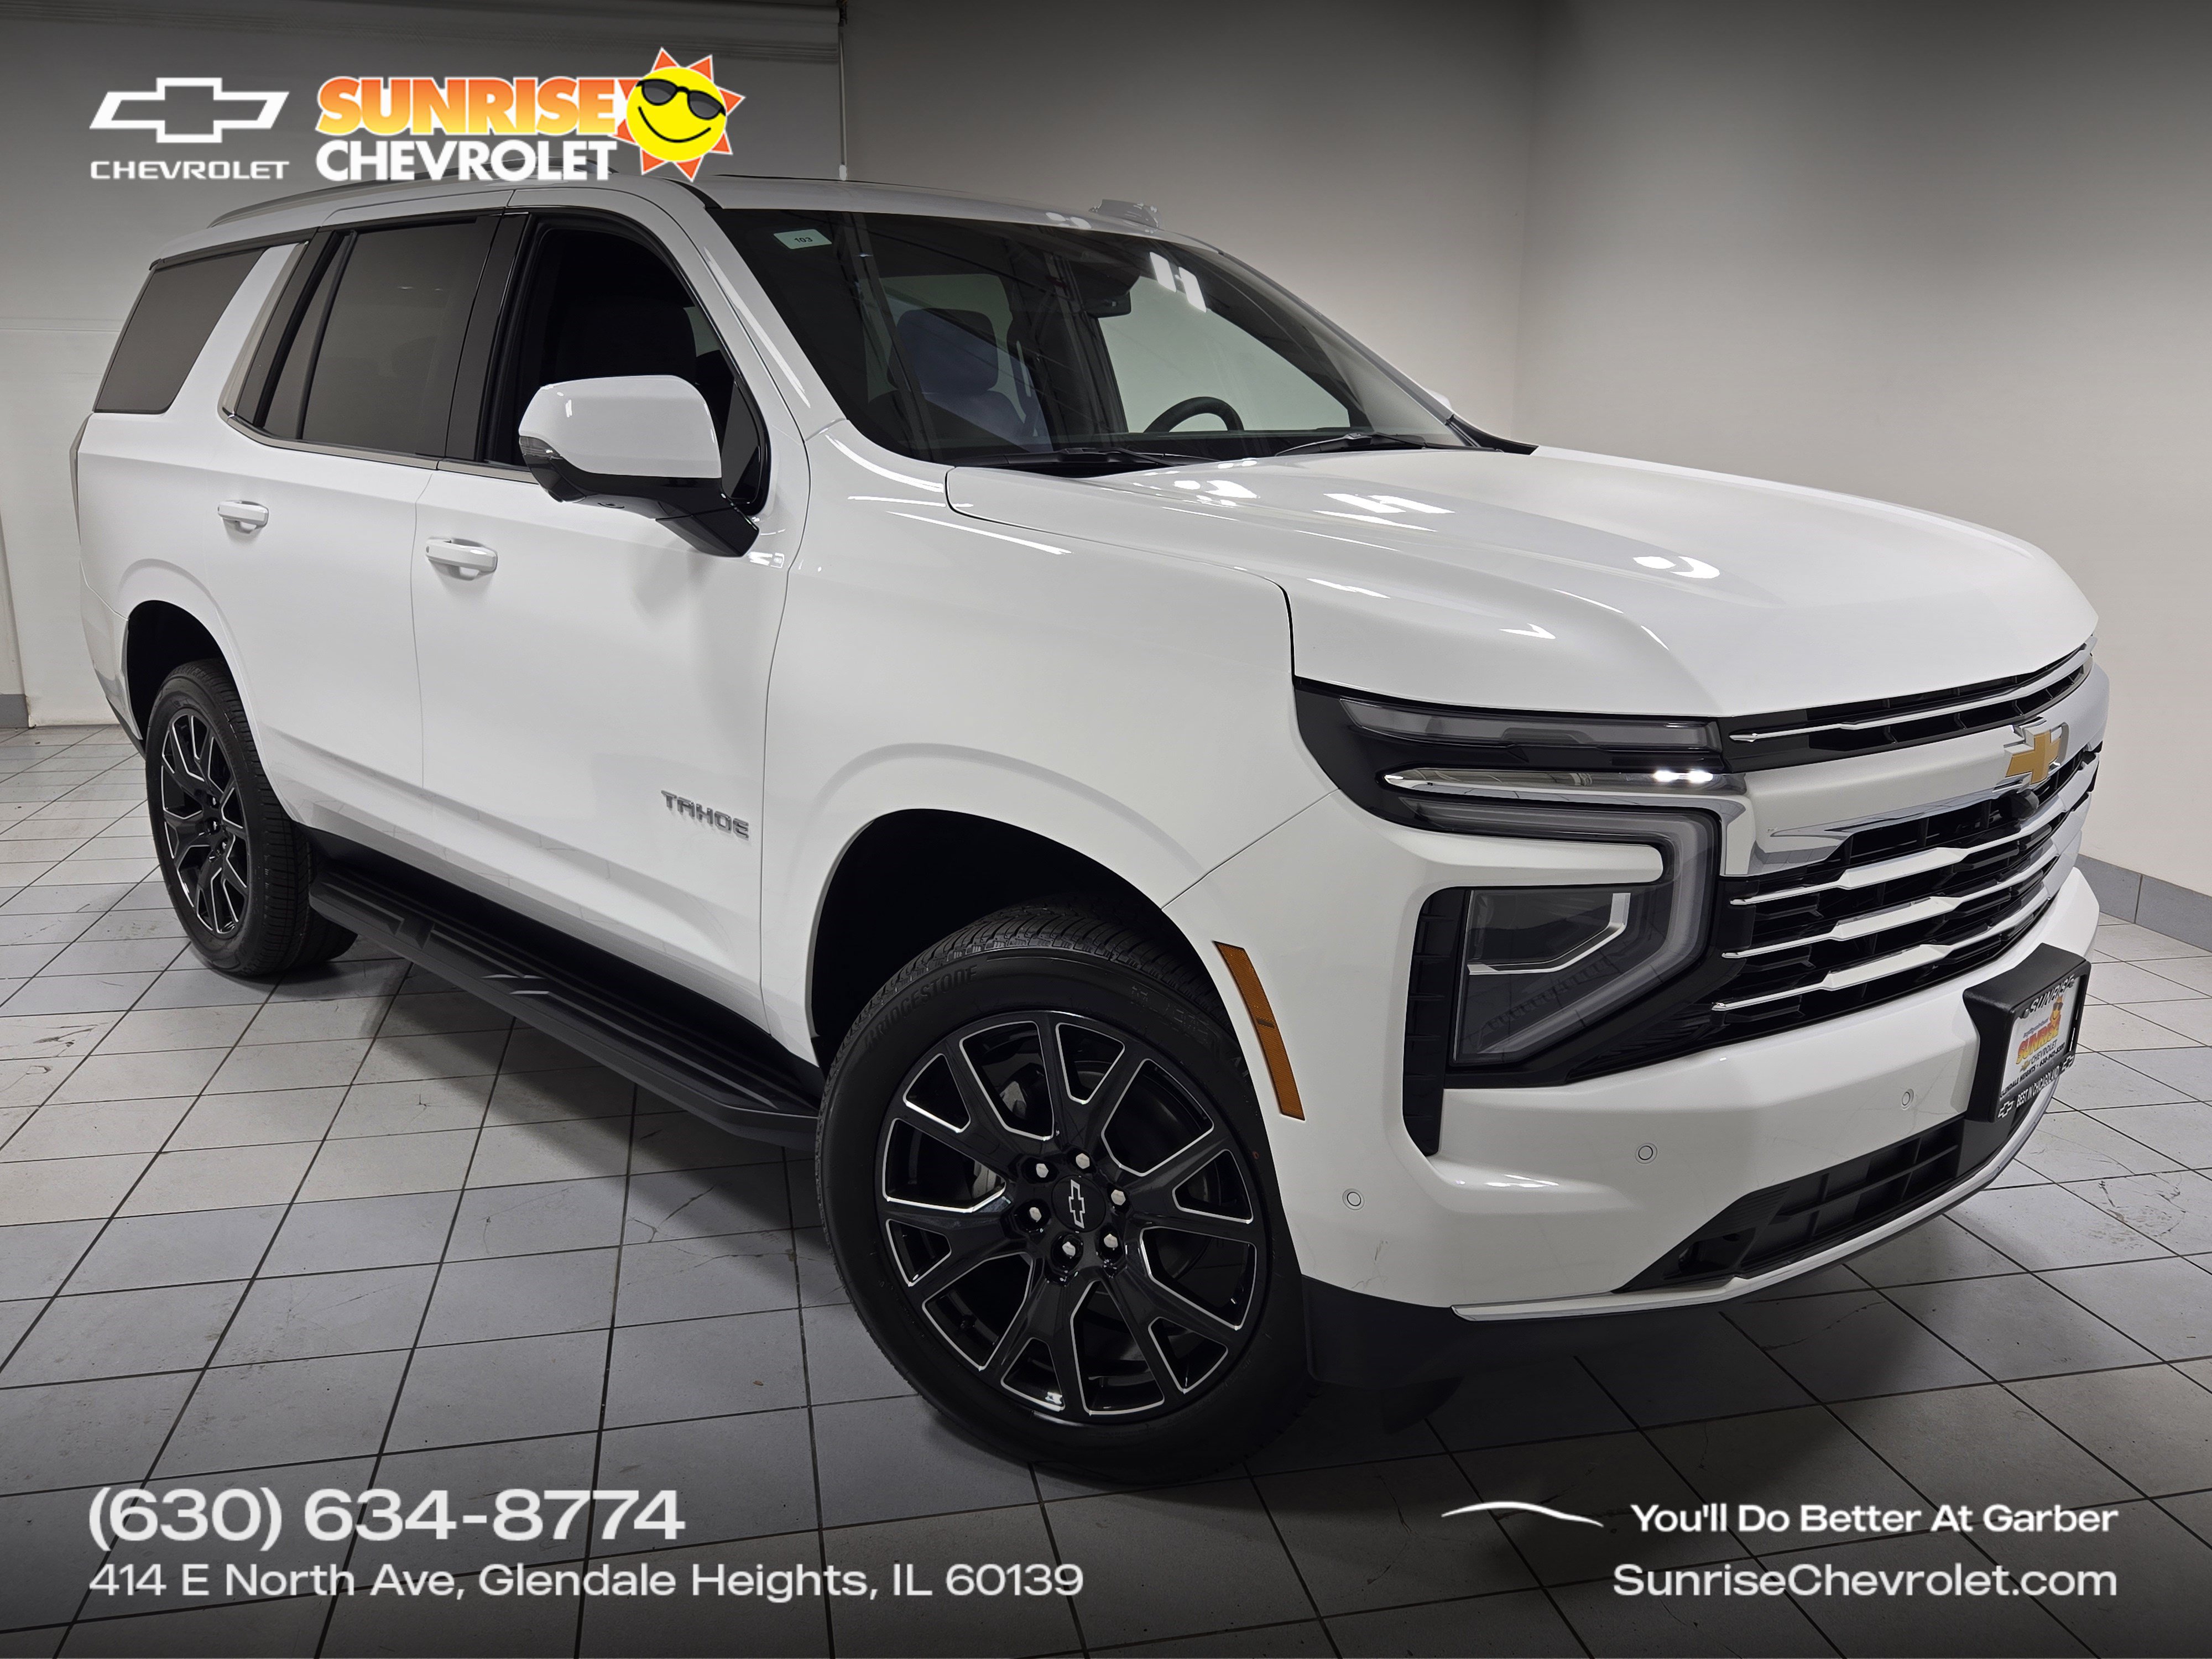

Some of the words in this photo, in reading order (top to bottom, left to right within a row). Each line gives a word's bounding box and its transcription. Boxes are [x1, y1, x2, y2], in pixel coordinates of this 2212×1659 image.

[661, 790, 749, 839] TAHOE
[864, 964, 978, 1052] BRIDGESTONE
[2030, 1039, 2058, 1065] CHEVROLET
[2016, 1089, 2029, 1108] BEST
